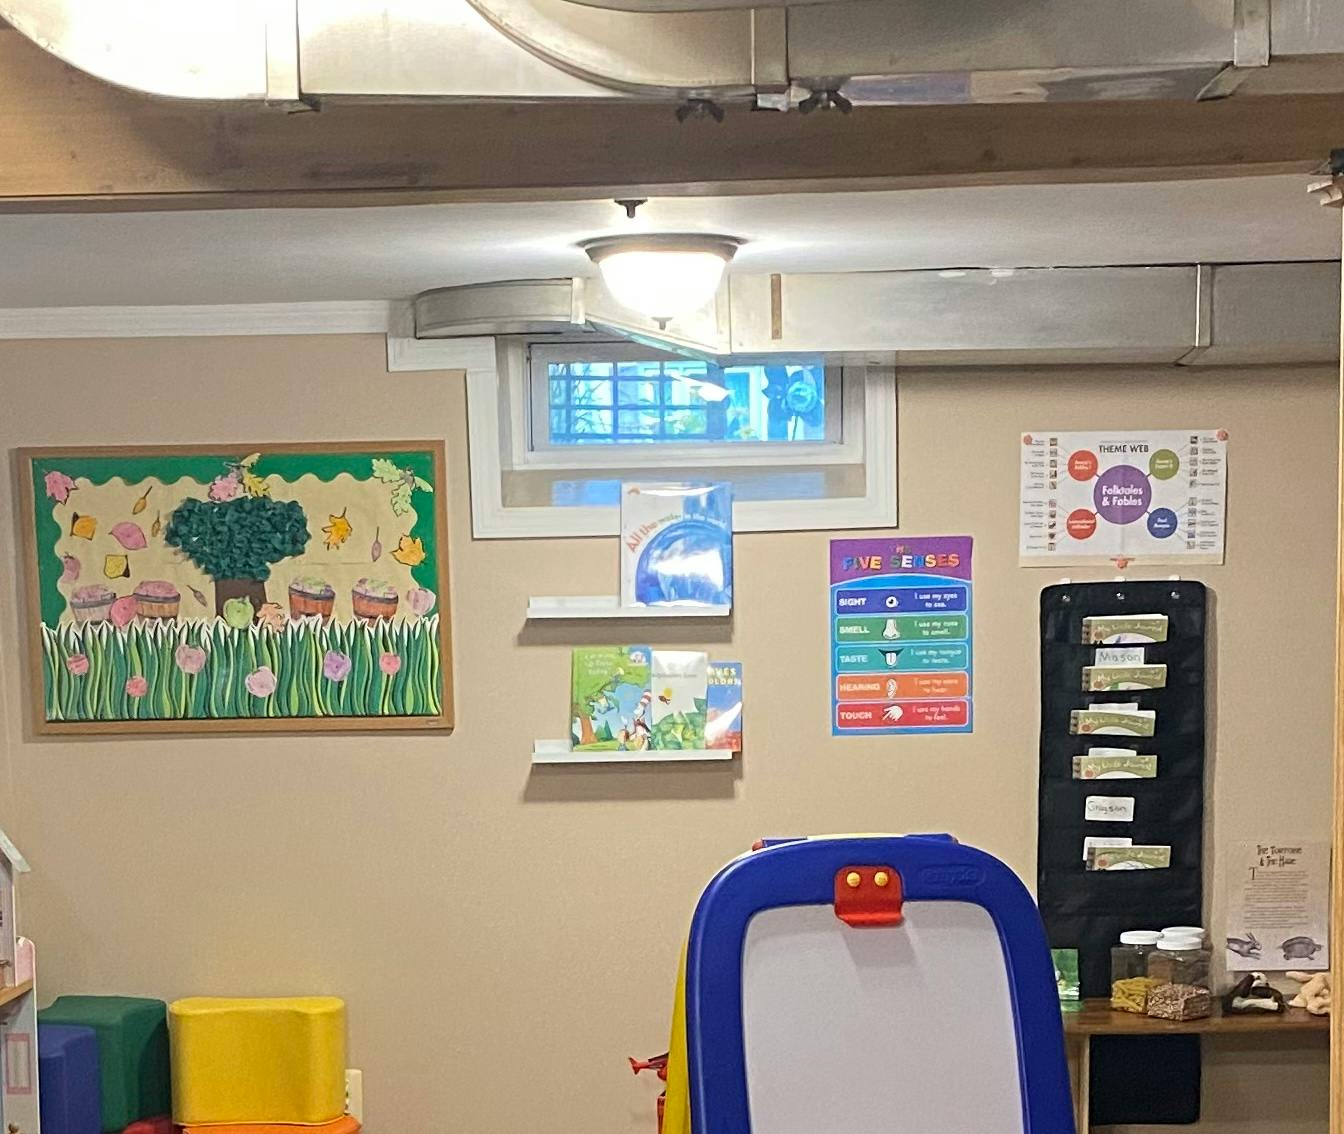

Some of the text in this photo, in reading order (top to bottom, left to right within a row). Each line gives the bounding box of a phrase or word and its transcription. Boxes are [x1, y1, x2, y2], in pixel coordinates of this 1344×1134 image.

[842, 553, 960, 571] FIVE SENSES
[838, 597, 867, 606] SIGHT
[839, 626, 870, 634] SMELL
[839, 654, 869, 664] TASTE
[1099, 651, 1141, 662] Mason
[839, 683, 881, 692] HEARING
[839, 711, 873, 720] TOUCH
